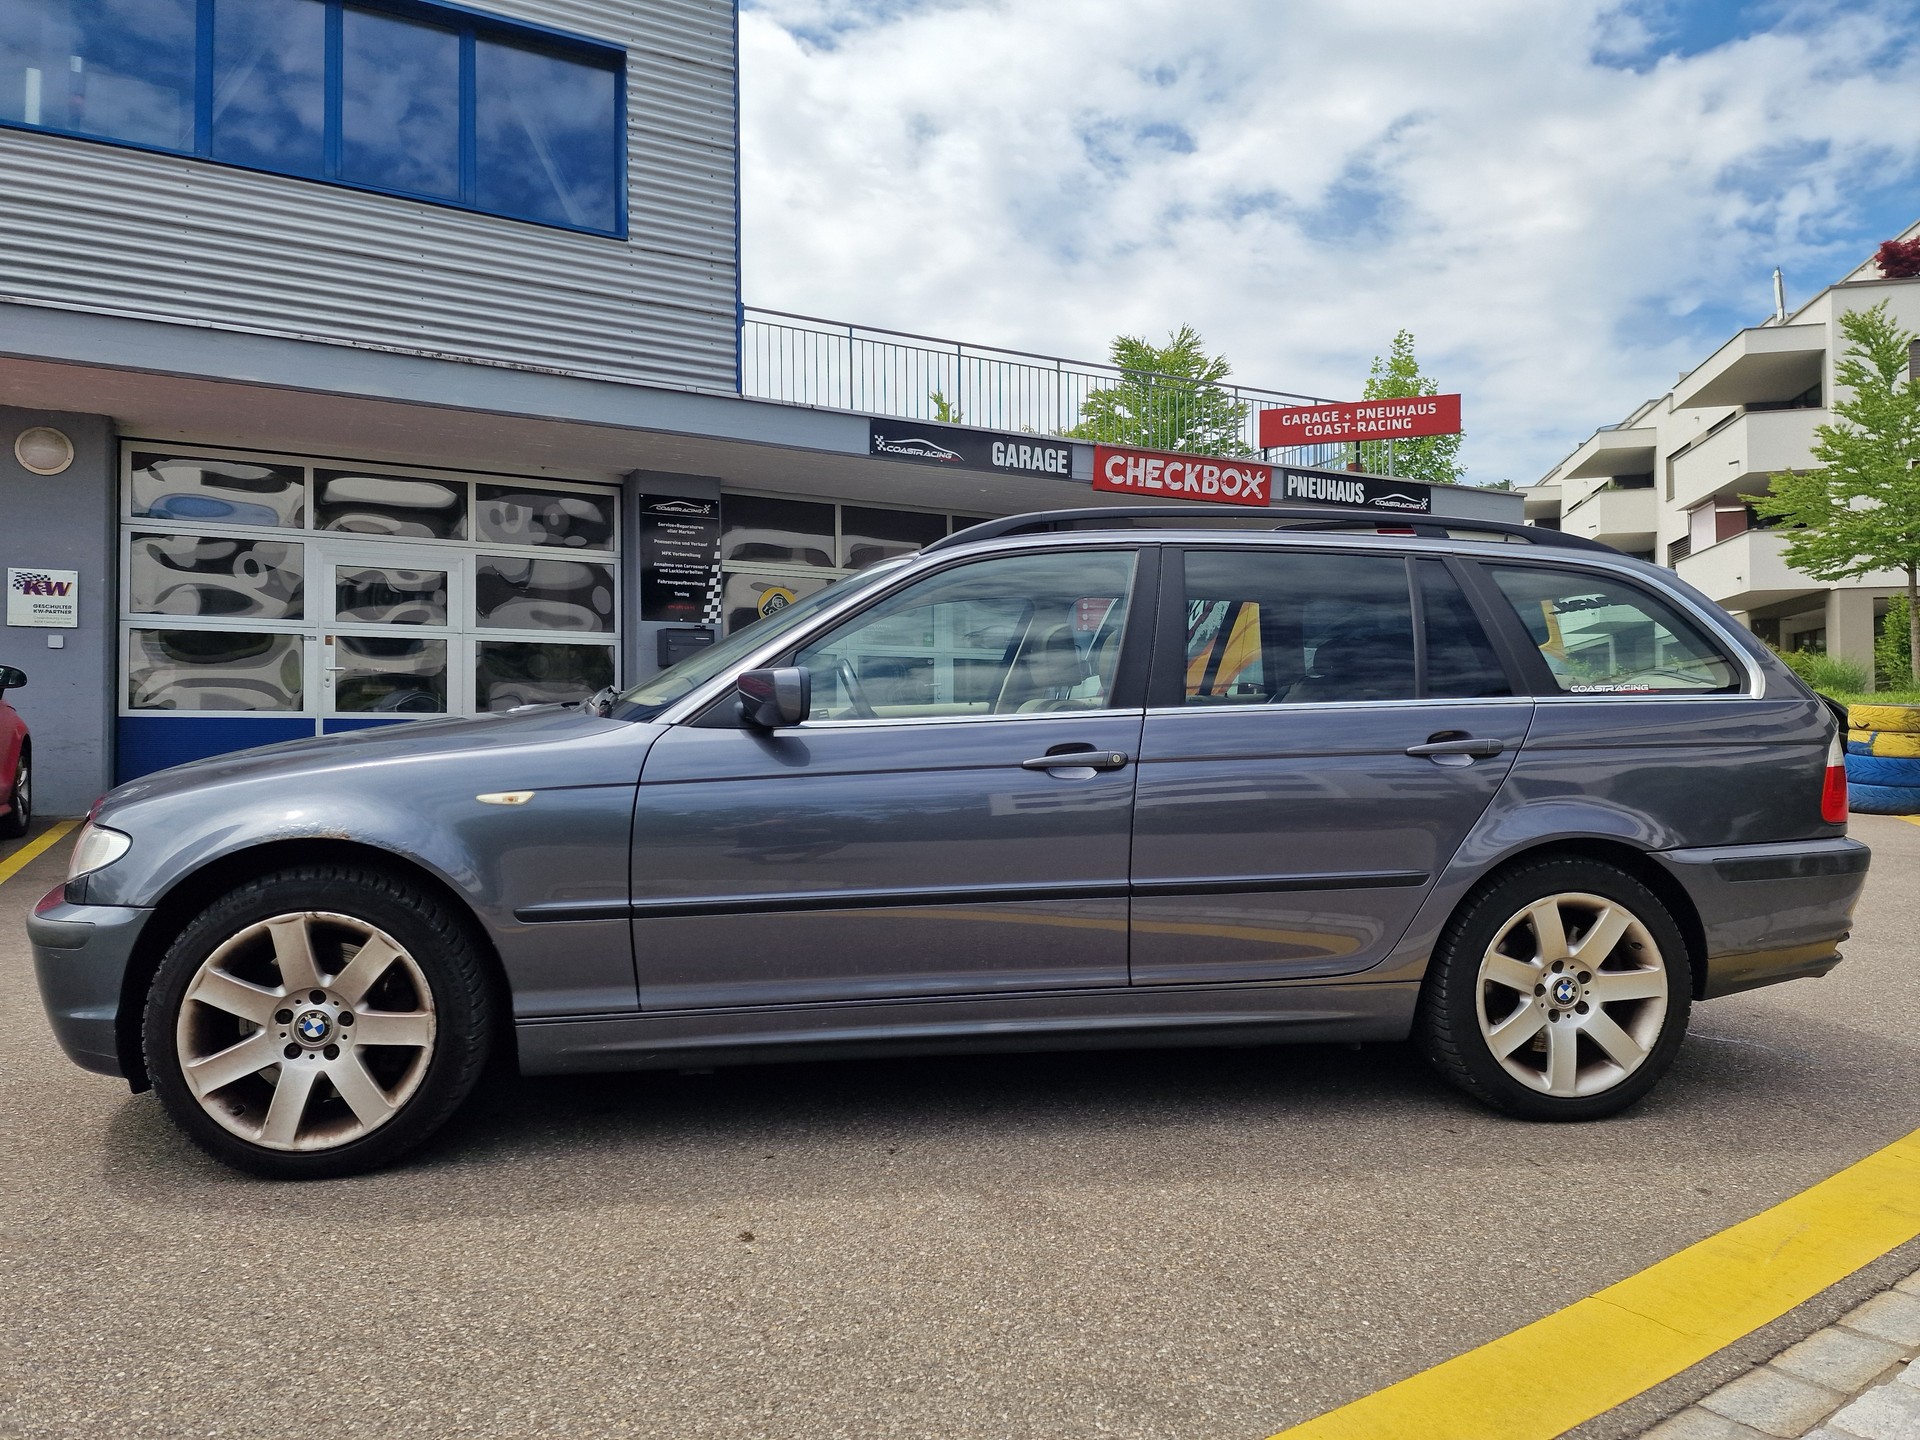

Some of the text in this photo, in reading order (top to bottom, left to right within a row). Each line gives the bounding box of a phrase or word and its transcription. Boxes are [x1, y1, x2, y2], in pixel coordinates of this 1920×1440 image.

[1282, 410, 1339, 426] GARAGE
[1356, 402, 1437, 420] PNEUHAUS
[1305, 417, 1412, 437] COAST-RACING
[886, 445, 952, 459] COASTRACING
[992, 441, 1068, 474] GARAGE
[1104, 455, 1266, 500] CHECKBOX
[1287, 475, 1365, 504] PNEUHAUS
[22, 579, 72, 597] KW
[1570, 684, 1649, 693] COASTRACING
